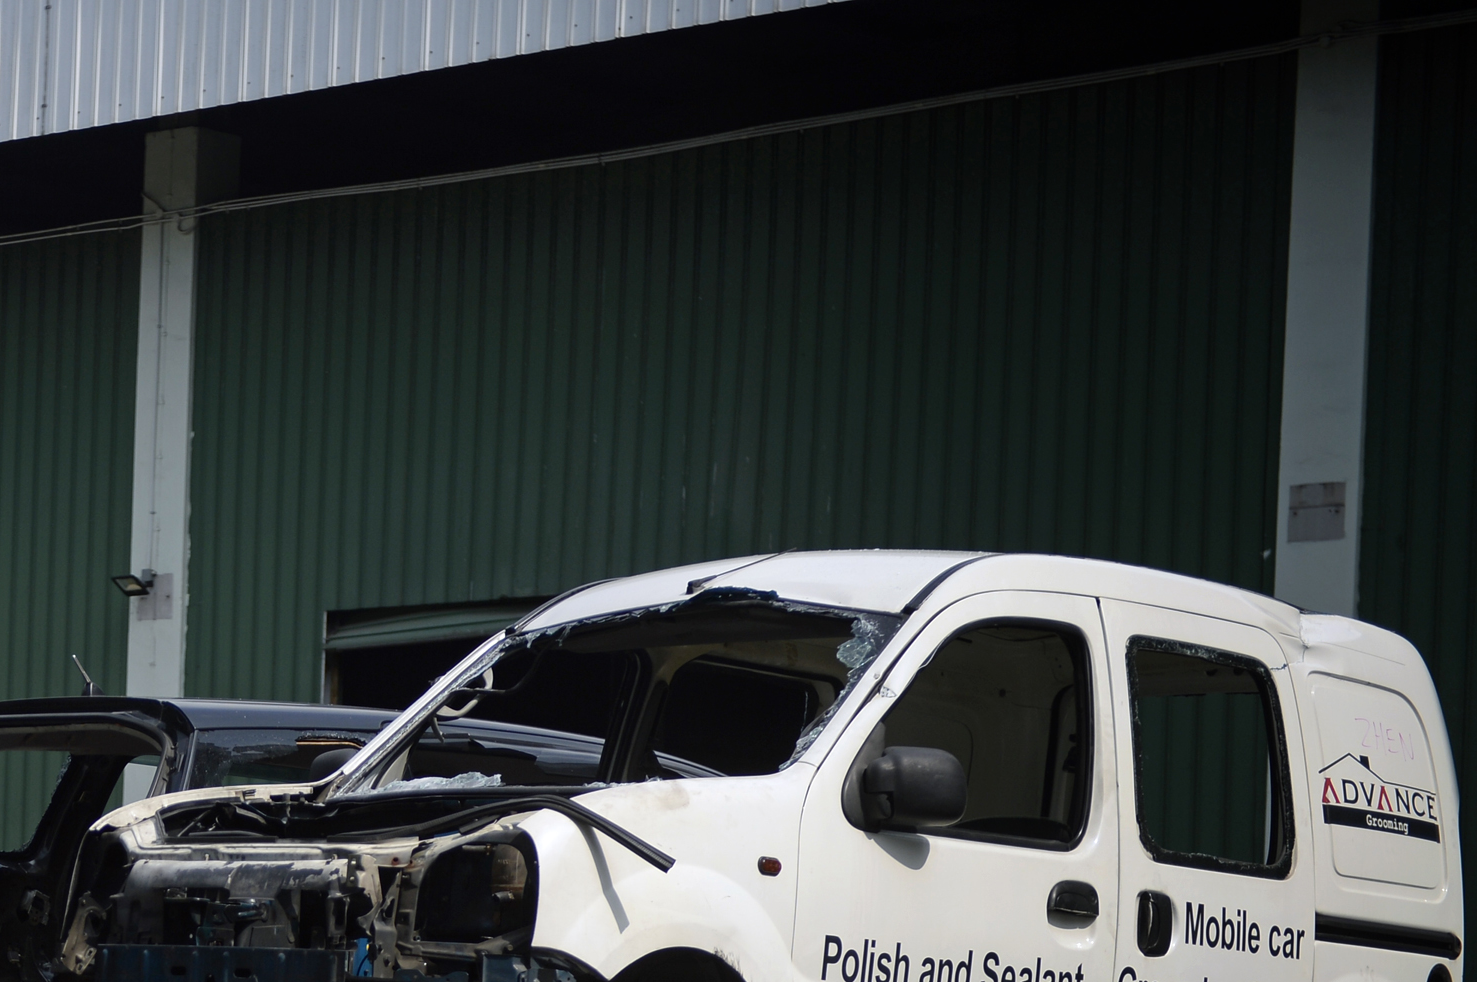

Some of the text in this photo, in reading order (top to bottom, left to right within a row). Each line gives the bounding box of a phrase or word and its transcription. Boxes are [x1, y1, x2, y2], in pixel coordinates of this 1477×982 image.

[1321, 777, 1438, 822] ADVANCE
[1365, 813, 1409, 835] Grooming
[1184, 901, 1306, 960] Mobile car
